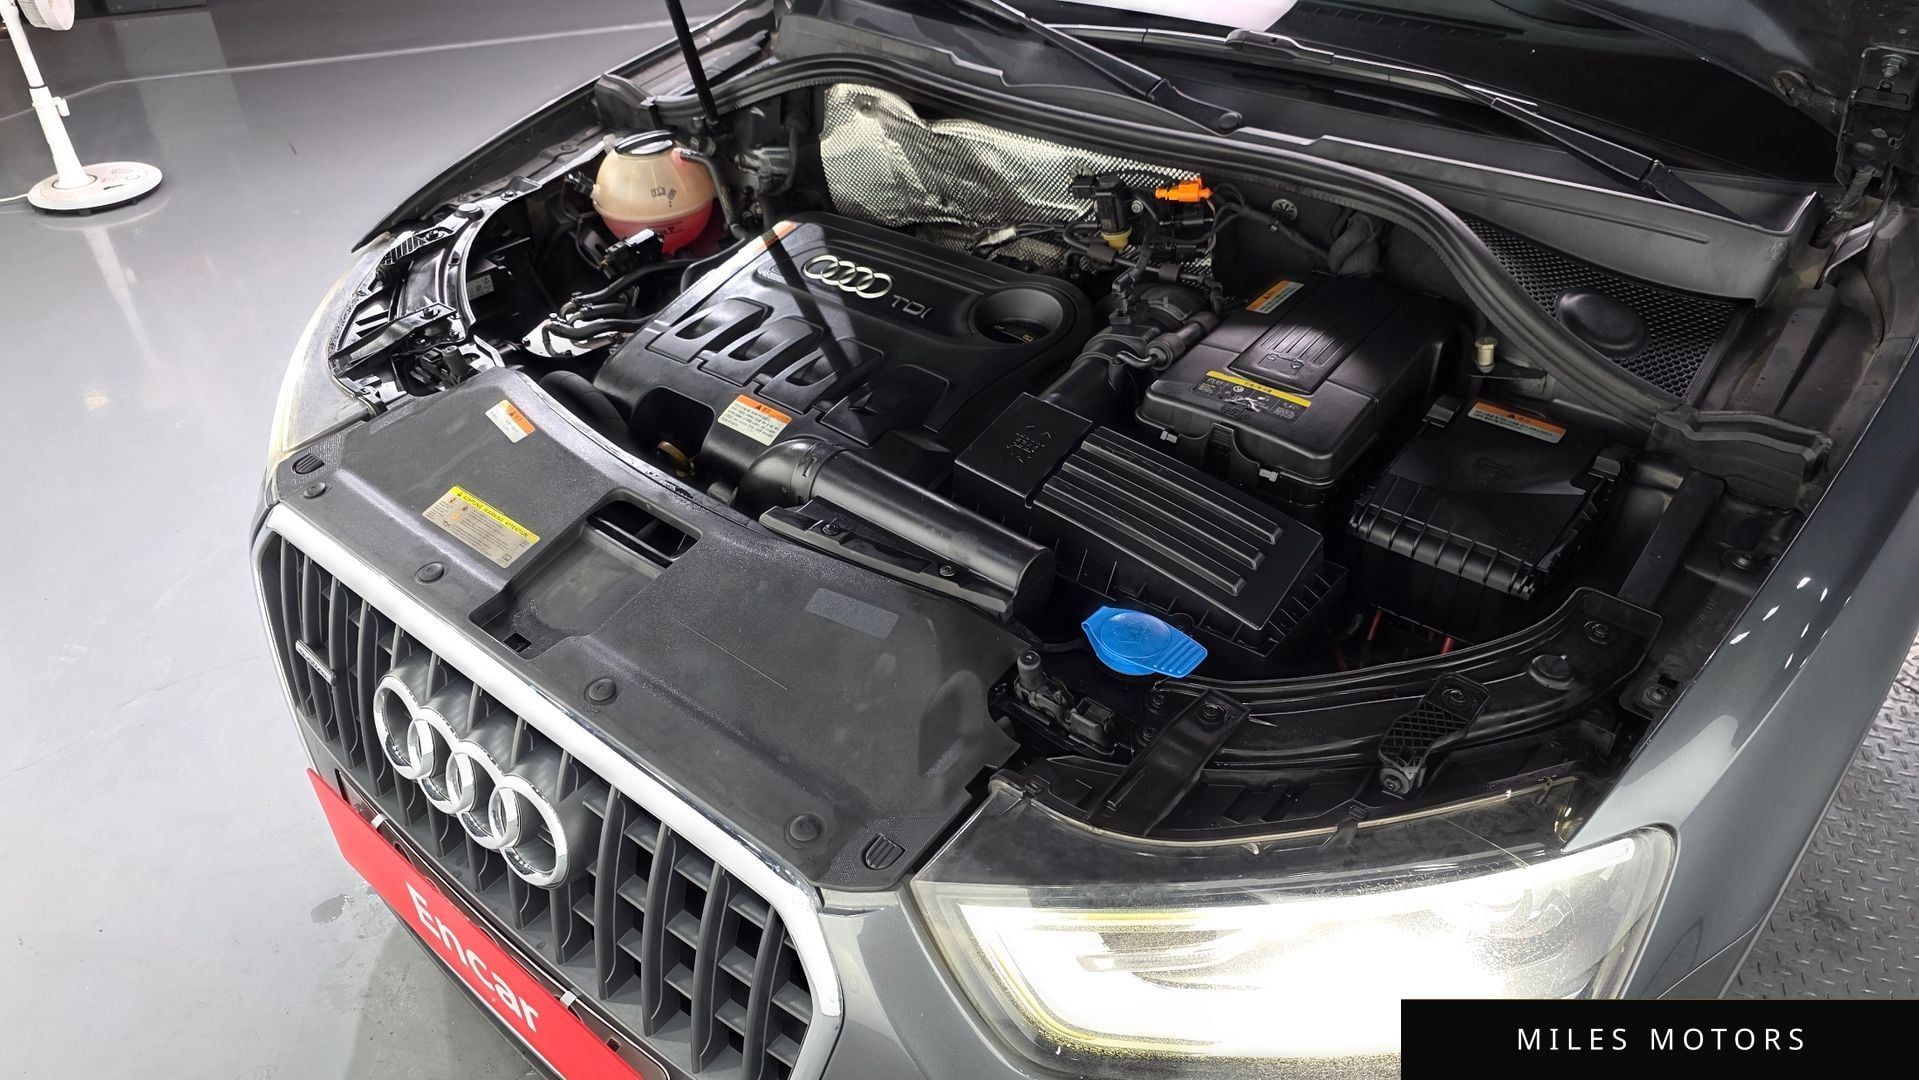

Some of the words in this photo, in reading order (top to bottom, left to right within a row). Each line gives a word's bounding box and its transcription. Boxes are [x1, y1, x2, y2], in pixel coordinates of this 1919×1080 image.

[892, 294, 932, 320] TDI
[505, 521, 529, 538] ATTENTION
[405, 881, 539, 1033] Encar
